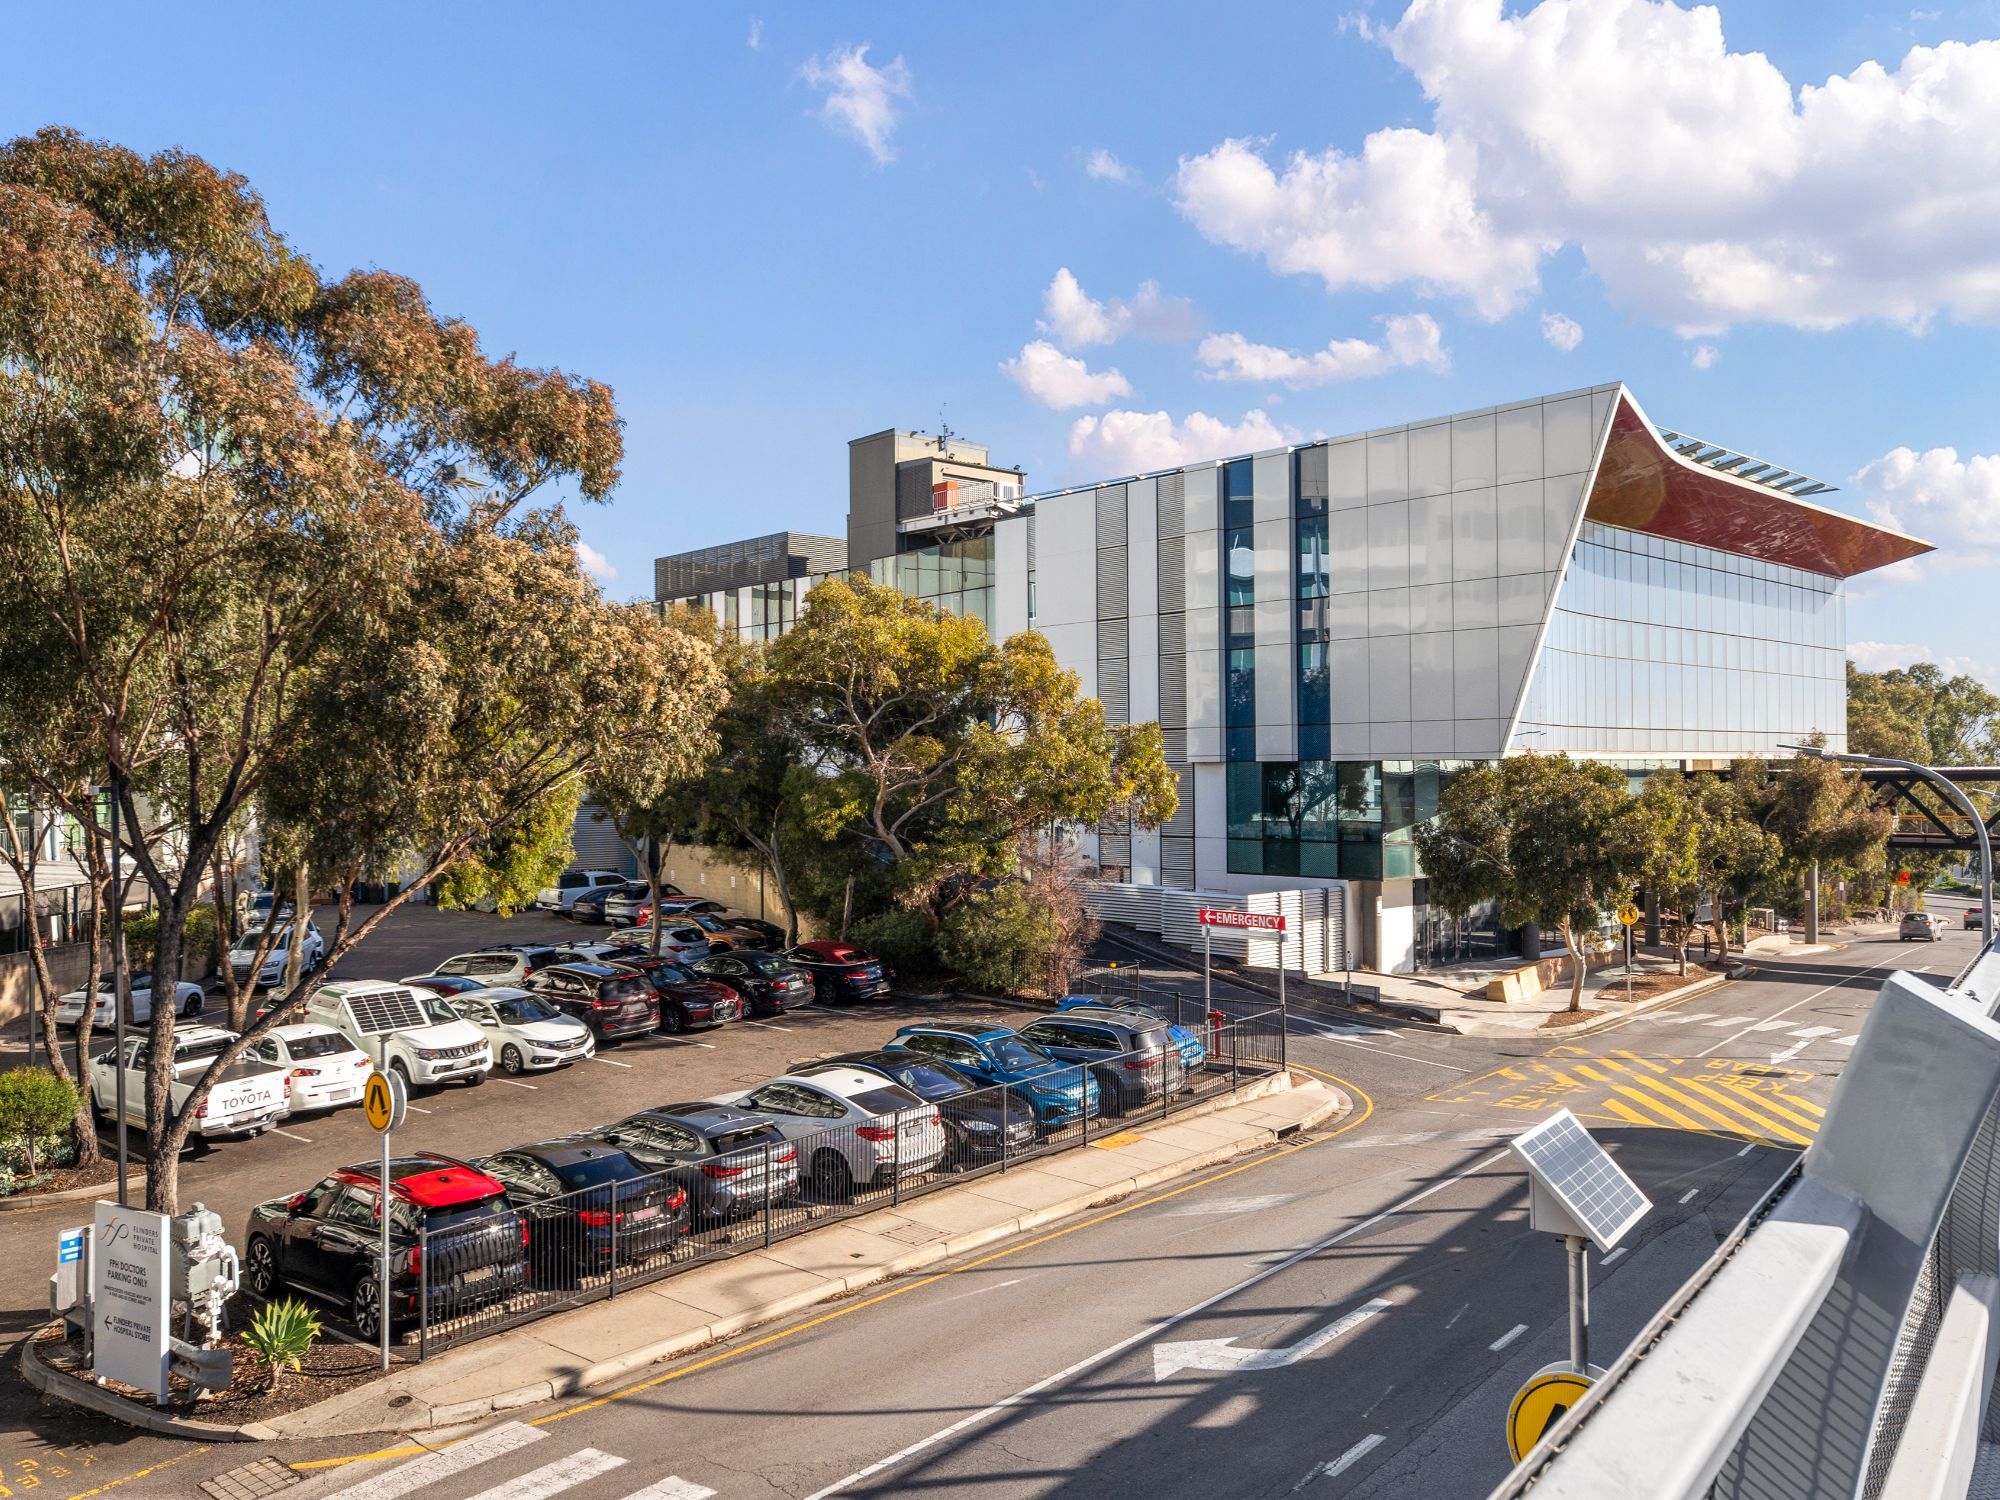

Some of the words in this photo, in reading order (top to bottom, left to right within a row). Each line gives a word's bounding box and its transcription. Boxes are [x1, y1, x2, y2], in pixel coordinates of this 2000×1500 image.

[1216, 912, 1280, 928] EMERGENCY
[222, 1090, 271, 1110] TOYOTA
[133, 1226, 158, 1237] FLINDERS
[133, 1235, 155, 1245] PRIVATE
[133, 1243, 158, 1254] HOSPITAL
[120, 1262, 146, 1276] DOCTORS
[107, 1270, 131, 1283] PARKING
[132, 1276, 148, 1288] ONLY
[113, 1316, 133, 1328] FLINDERS
[133, 1322, 151, 1333] PRIVATE
[113, 1325, 134, 1337] HOSPITAL
[134, 1331, 151, 1342] STORES
